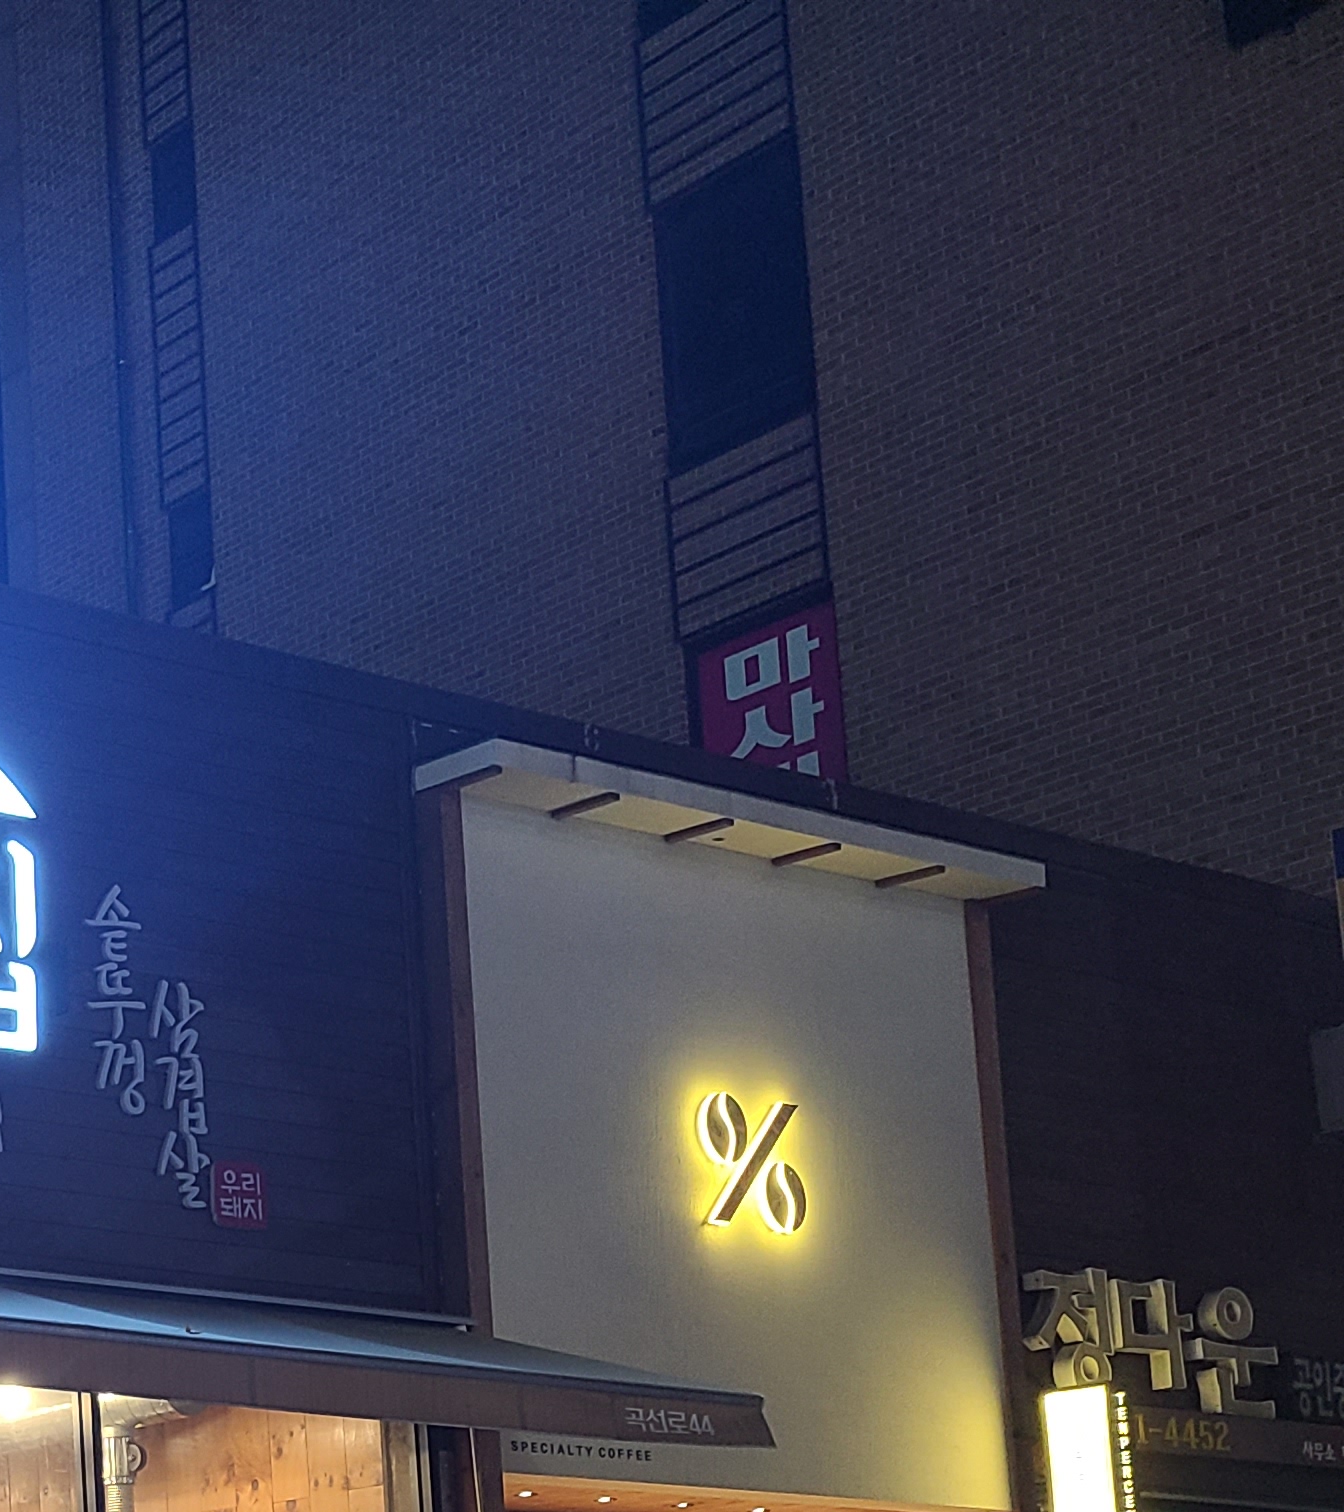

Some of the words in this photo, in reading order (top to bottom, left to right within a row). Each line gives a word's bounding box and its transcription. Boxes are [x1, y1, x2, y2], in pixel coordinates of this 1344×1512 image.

[721, 622, 825, 780] 마사
[220, 1169, 262, 1196] 우리
[219, 1197, 263, 1221] 돼지
[1021, 1266, 1281, 1420] 정다운
[624, 1406, 716, 1437] 곡선로44
[510, 1440, 593, 1458] SPECIALTY
[598, 1447, 653, 1462] COFFEE
